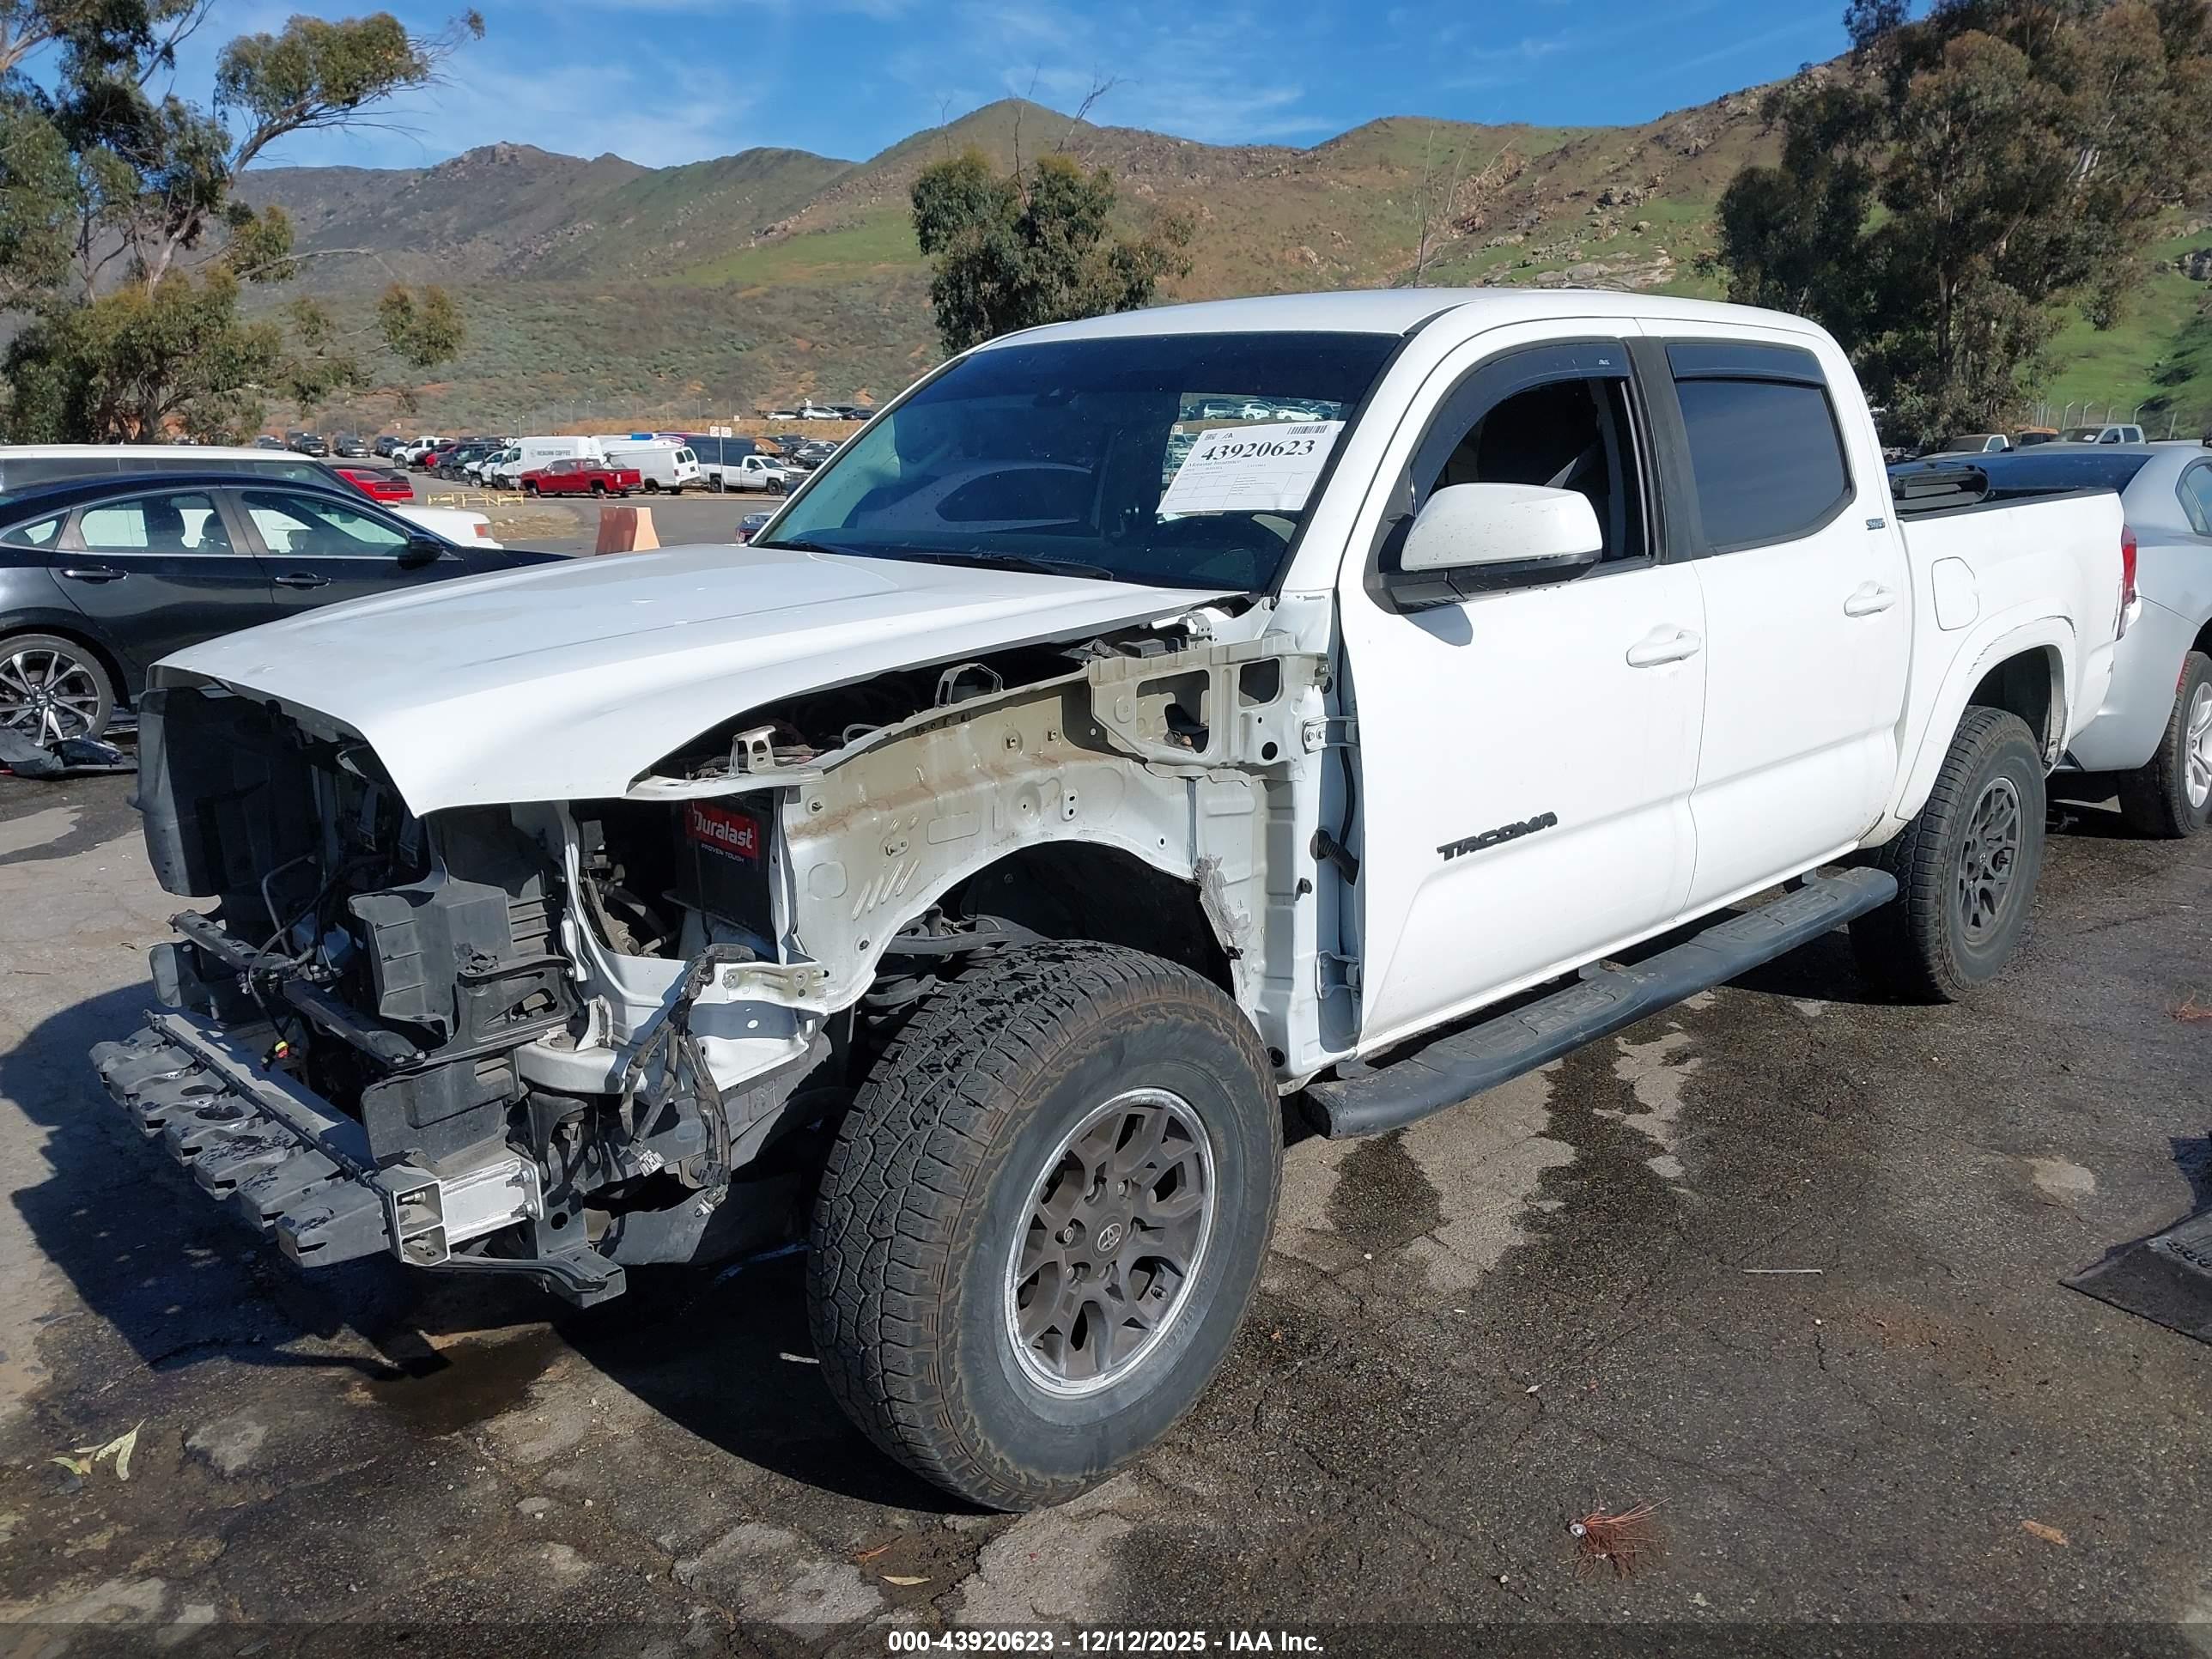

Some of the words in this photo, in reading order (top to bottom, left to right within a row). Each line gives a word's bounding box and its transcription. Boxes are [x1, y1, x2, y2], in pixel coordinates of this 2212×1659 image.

[1201, 440, 1316, 460] 43920623
[693, 810, 753, 849] Duralast
[1437, 811, 1558, 861] TACOMA
